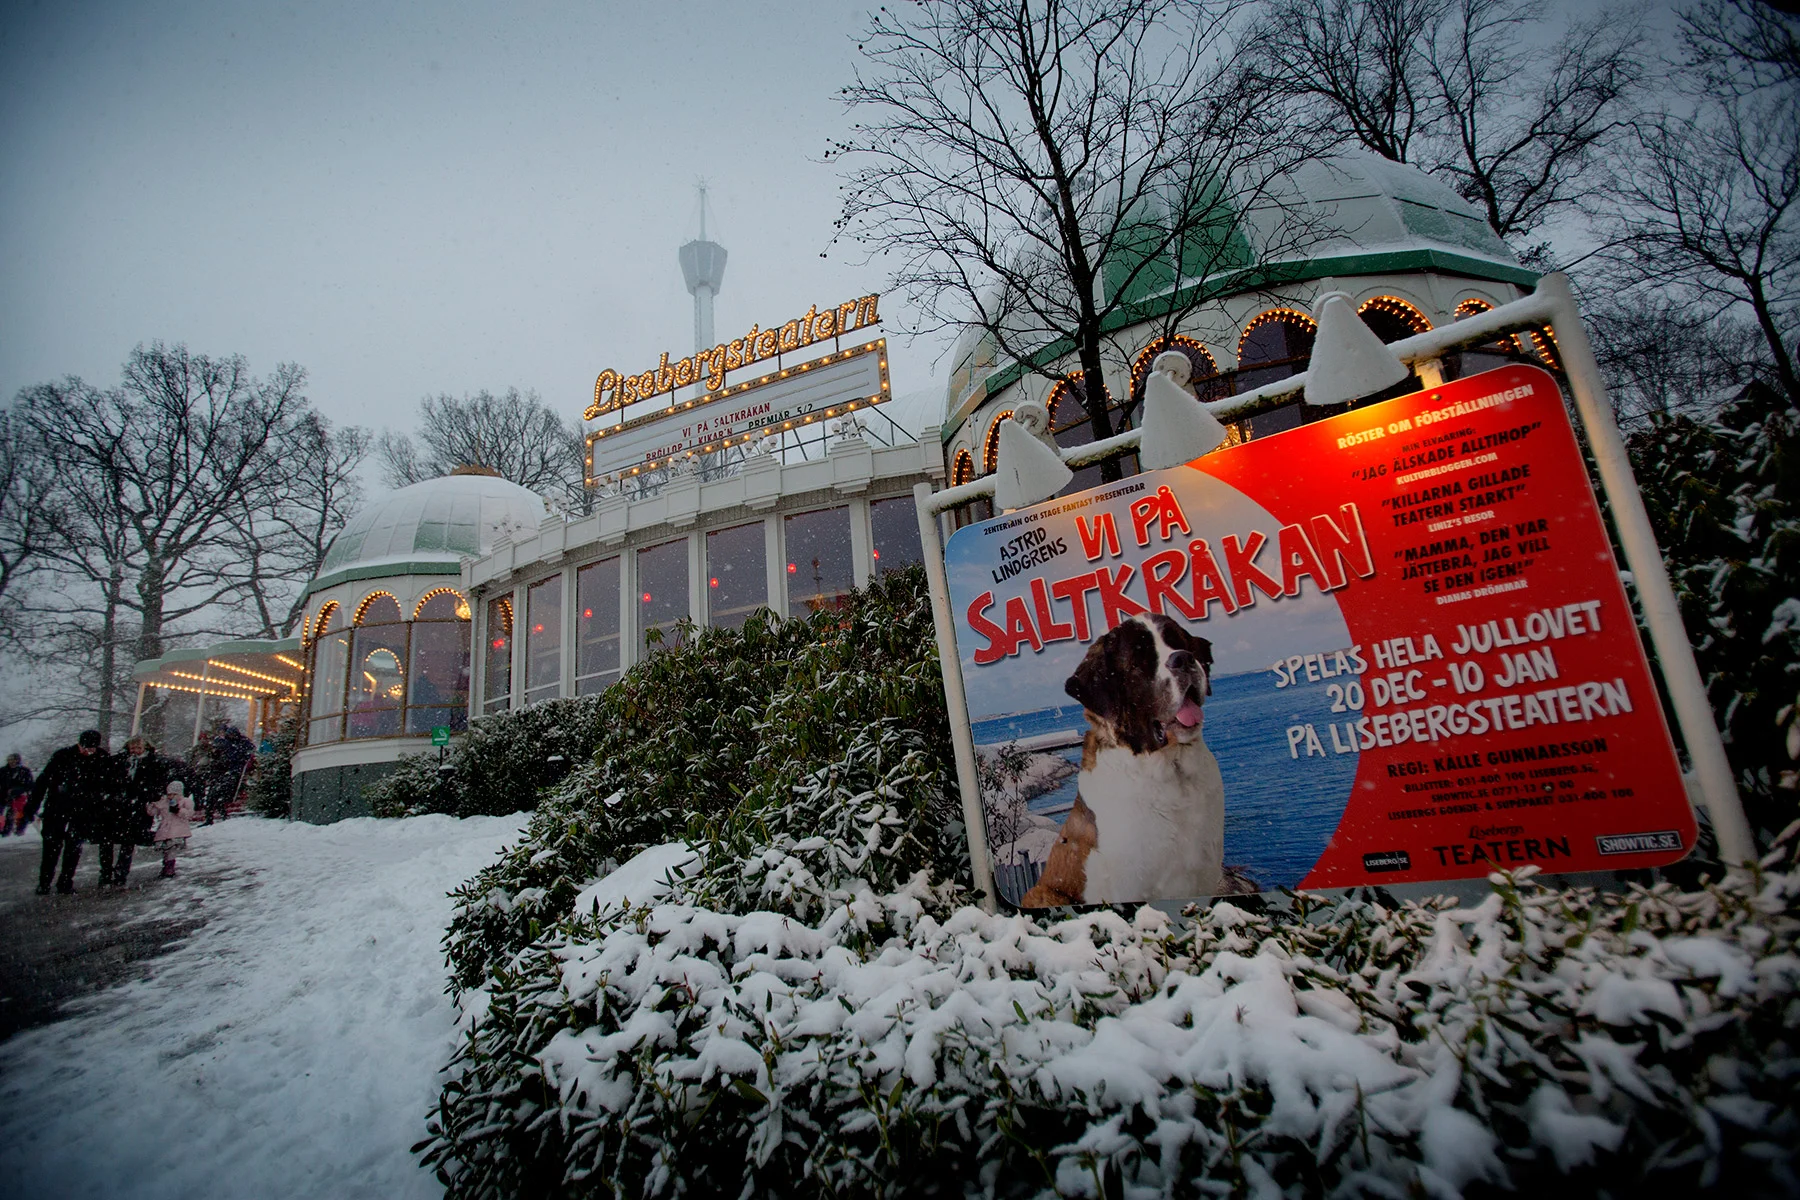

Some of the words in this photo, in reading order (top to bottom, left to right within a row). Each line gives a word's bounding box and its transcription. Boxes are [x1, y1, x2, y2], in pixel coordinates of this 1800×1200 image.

[583, 293, 880, 420] Lisebergsteatern
[682, 428, 691, 438] VI
[697, 422, 709, 434] PÅ
[714, 402, 771, 428] SALTKRÅKAN
[748, 409, 790, 430] PREMIÄR
[1337, 427, 1386, 449] RÖSTER
[1388, 419, 1412, 434] OM
[1415, 384, 1535, 428] FÖRSTÄLLNINGEN
[1393, 445, 1455, 473] ÄLSKADE
[1461, 421, 1542, 455] ALLTIHOP"
[1402, 441, 1421, 453] MIN
[1396, 452, 1498, 485] KULTURBLOGGEN.COM
[1468, 464, 1531, 491] GILLADE
[1023, 514, 1039, 524] OCH
[1040, 507, 1061, 520] STAGE
[1062, 497, 1093, 513] FANTASY
[1095, 482, 1146, 504] PRESENTERAR
[1392, 502, 1455, 527] TEATERN
[1459, 484, 1526, 512] STARKT"
[1464, 510, 1496, 525] RESOR
[1075, 512, 1122, 561] VI
[1129, 484, 1192, 547] PÅ
[1480, 526, 1511, 546] DEN
[1516, 519, 1549, 537] VAR
[992, 537, 1068, 584] LINDGRENS
[1000, 527, 1047, 561] ASTRID
[1482, 546, 1512, 563] JAG
[1517, 537, 1551, 556] VILL
[967, 502, 1375, 666] SALTKRÅKAN
[1424, 579, 1440, 594] SE
[1445, 572, 1474, 590] DEN
[1435, 591, 1472, 605] DIANAS
[1474, 579, 1529, 598] DRÖMMAR
[1272, 645, 1369, 690] SPELAS
[1373, 633, 1443, 669] HELA
[1452, 600, 1602, 655] JULLOVET
[1326, 681, 1365, 714] 20
[1373, 670, 1426, 706] DEC
[1494, 646, 1559, 689] JAN
[1286, 722, 1326, 760] PÅ
[1329, 678, 1634, 755] LISEBERGSTEATERN
[1387, 761, 1429, 778] REGI:
[1487, 738, 1608, 766] GUNNARSSON
[1404, 779, 1454, 793] BILJETTER:
[1388, 807, 1437, 821] LISEBERGS
[1433, 836, 1572, 867] TEATERN
[1602, 834, 1677, 852] SHOWTIC.SE
